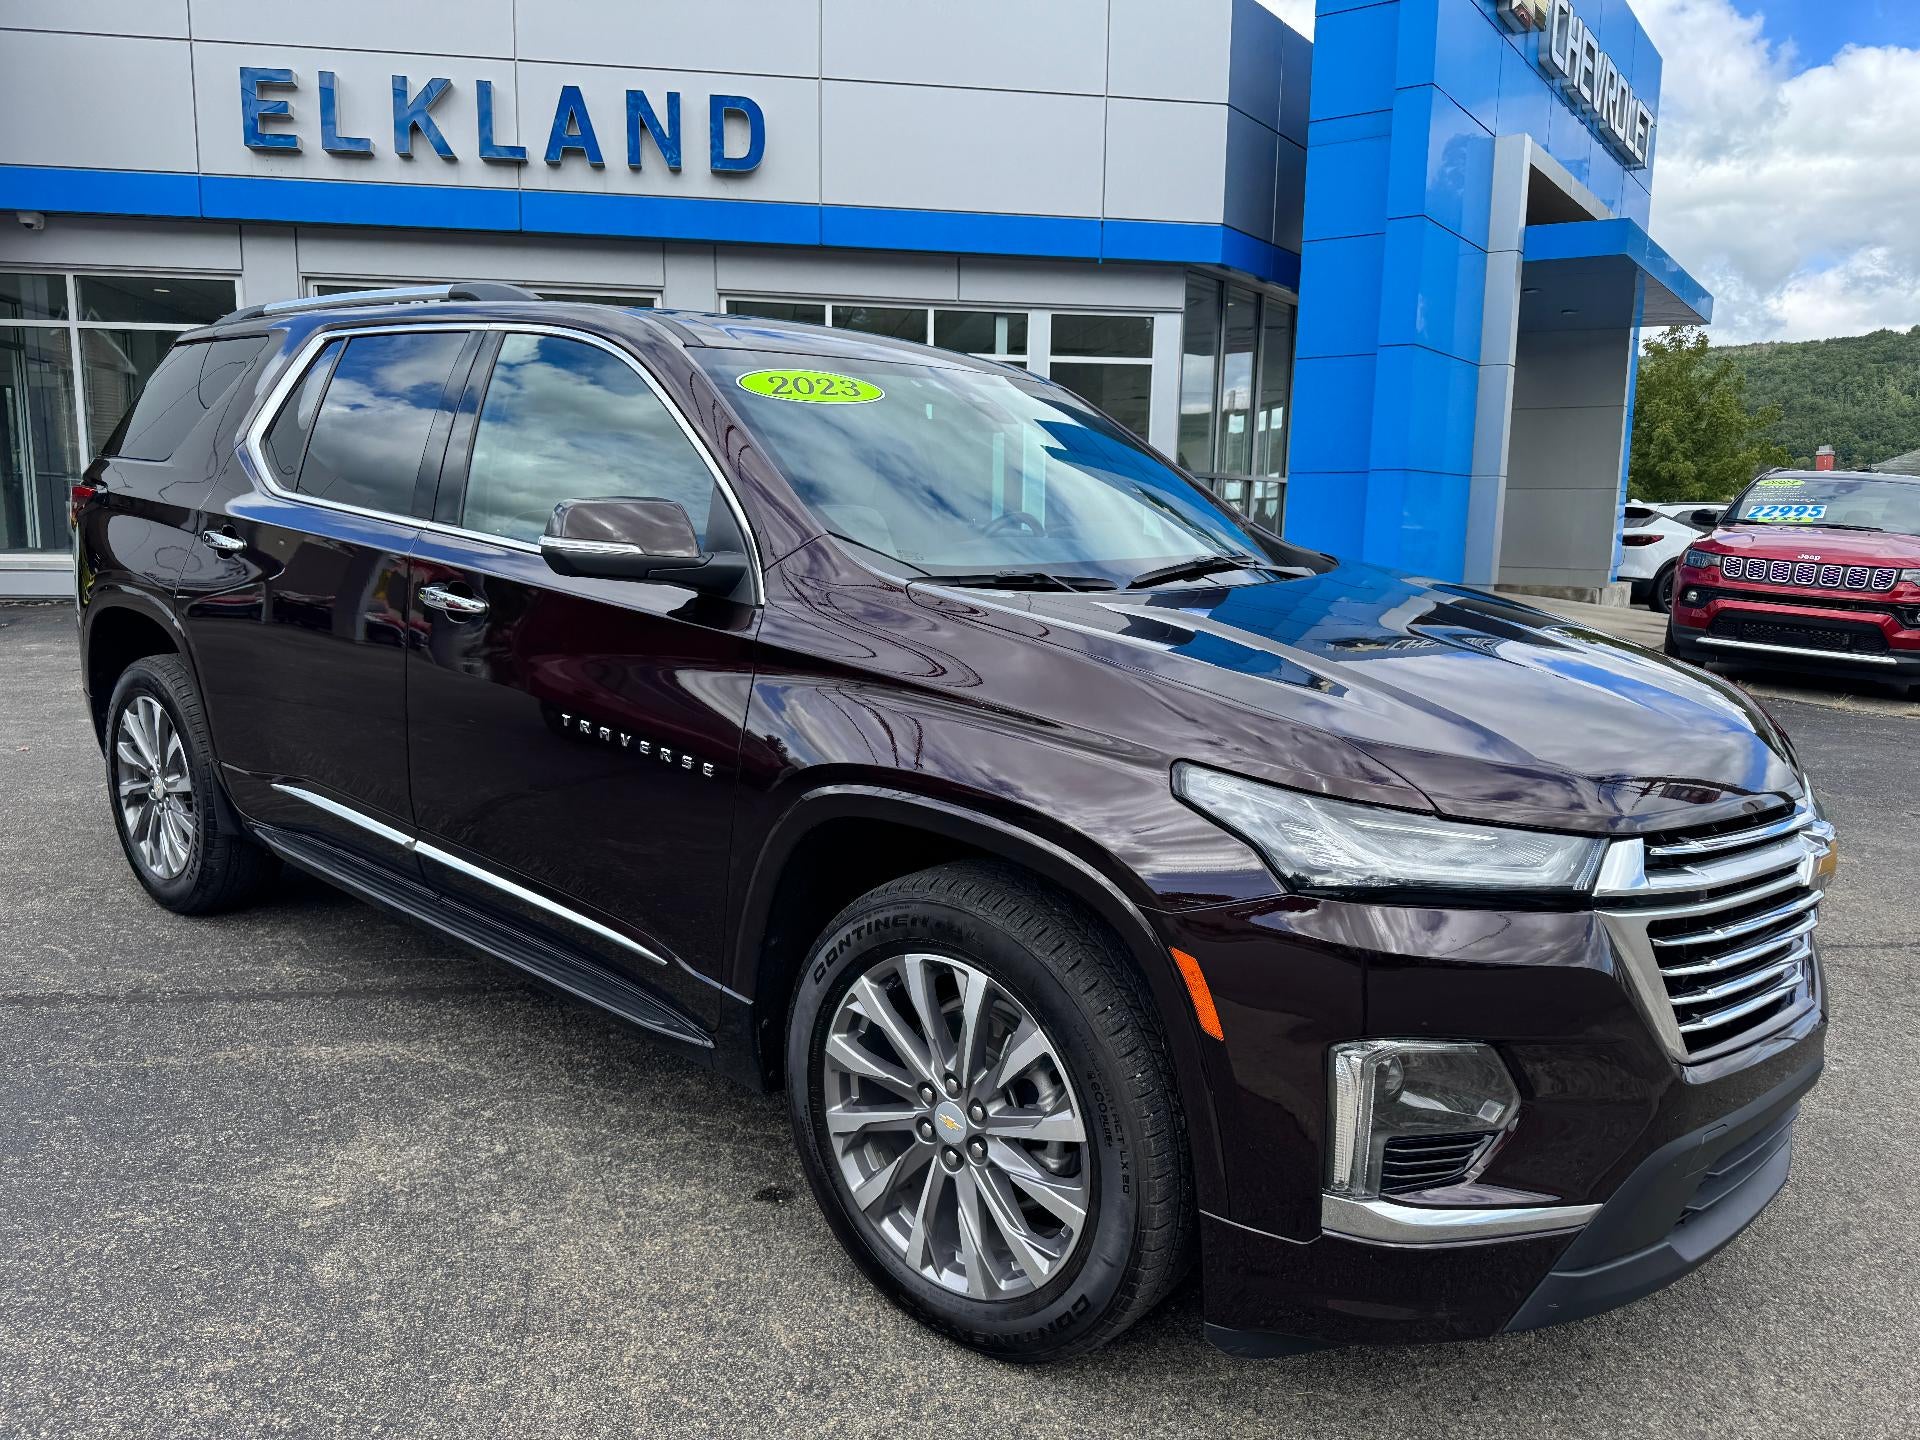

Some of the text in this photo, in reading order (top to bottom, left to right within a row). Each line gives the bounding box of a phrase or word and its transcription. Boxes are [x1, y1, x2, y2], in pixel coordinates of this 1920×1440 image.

[1545, 0, 1655, 169] CHEVROLET
[240, 67, 766, 174] ELKLAND
[768, 376, 861, 397] 2023
[1747, 505, 1825, 518] 22995
[1797, 553, 1821, 561] Jeep
[562, 714, 714, 777] TRAVERSE
